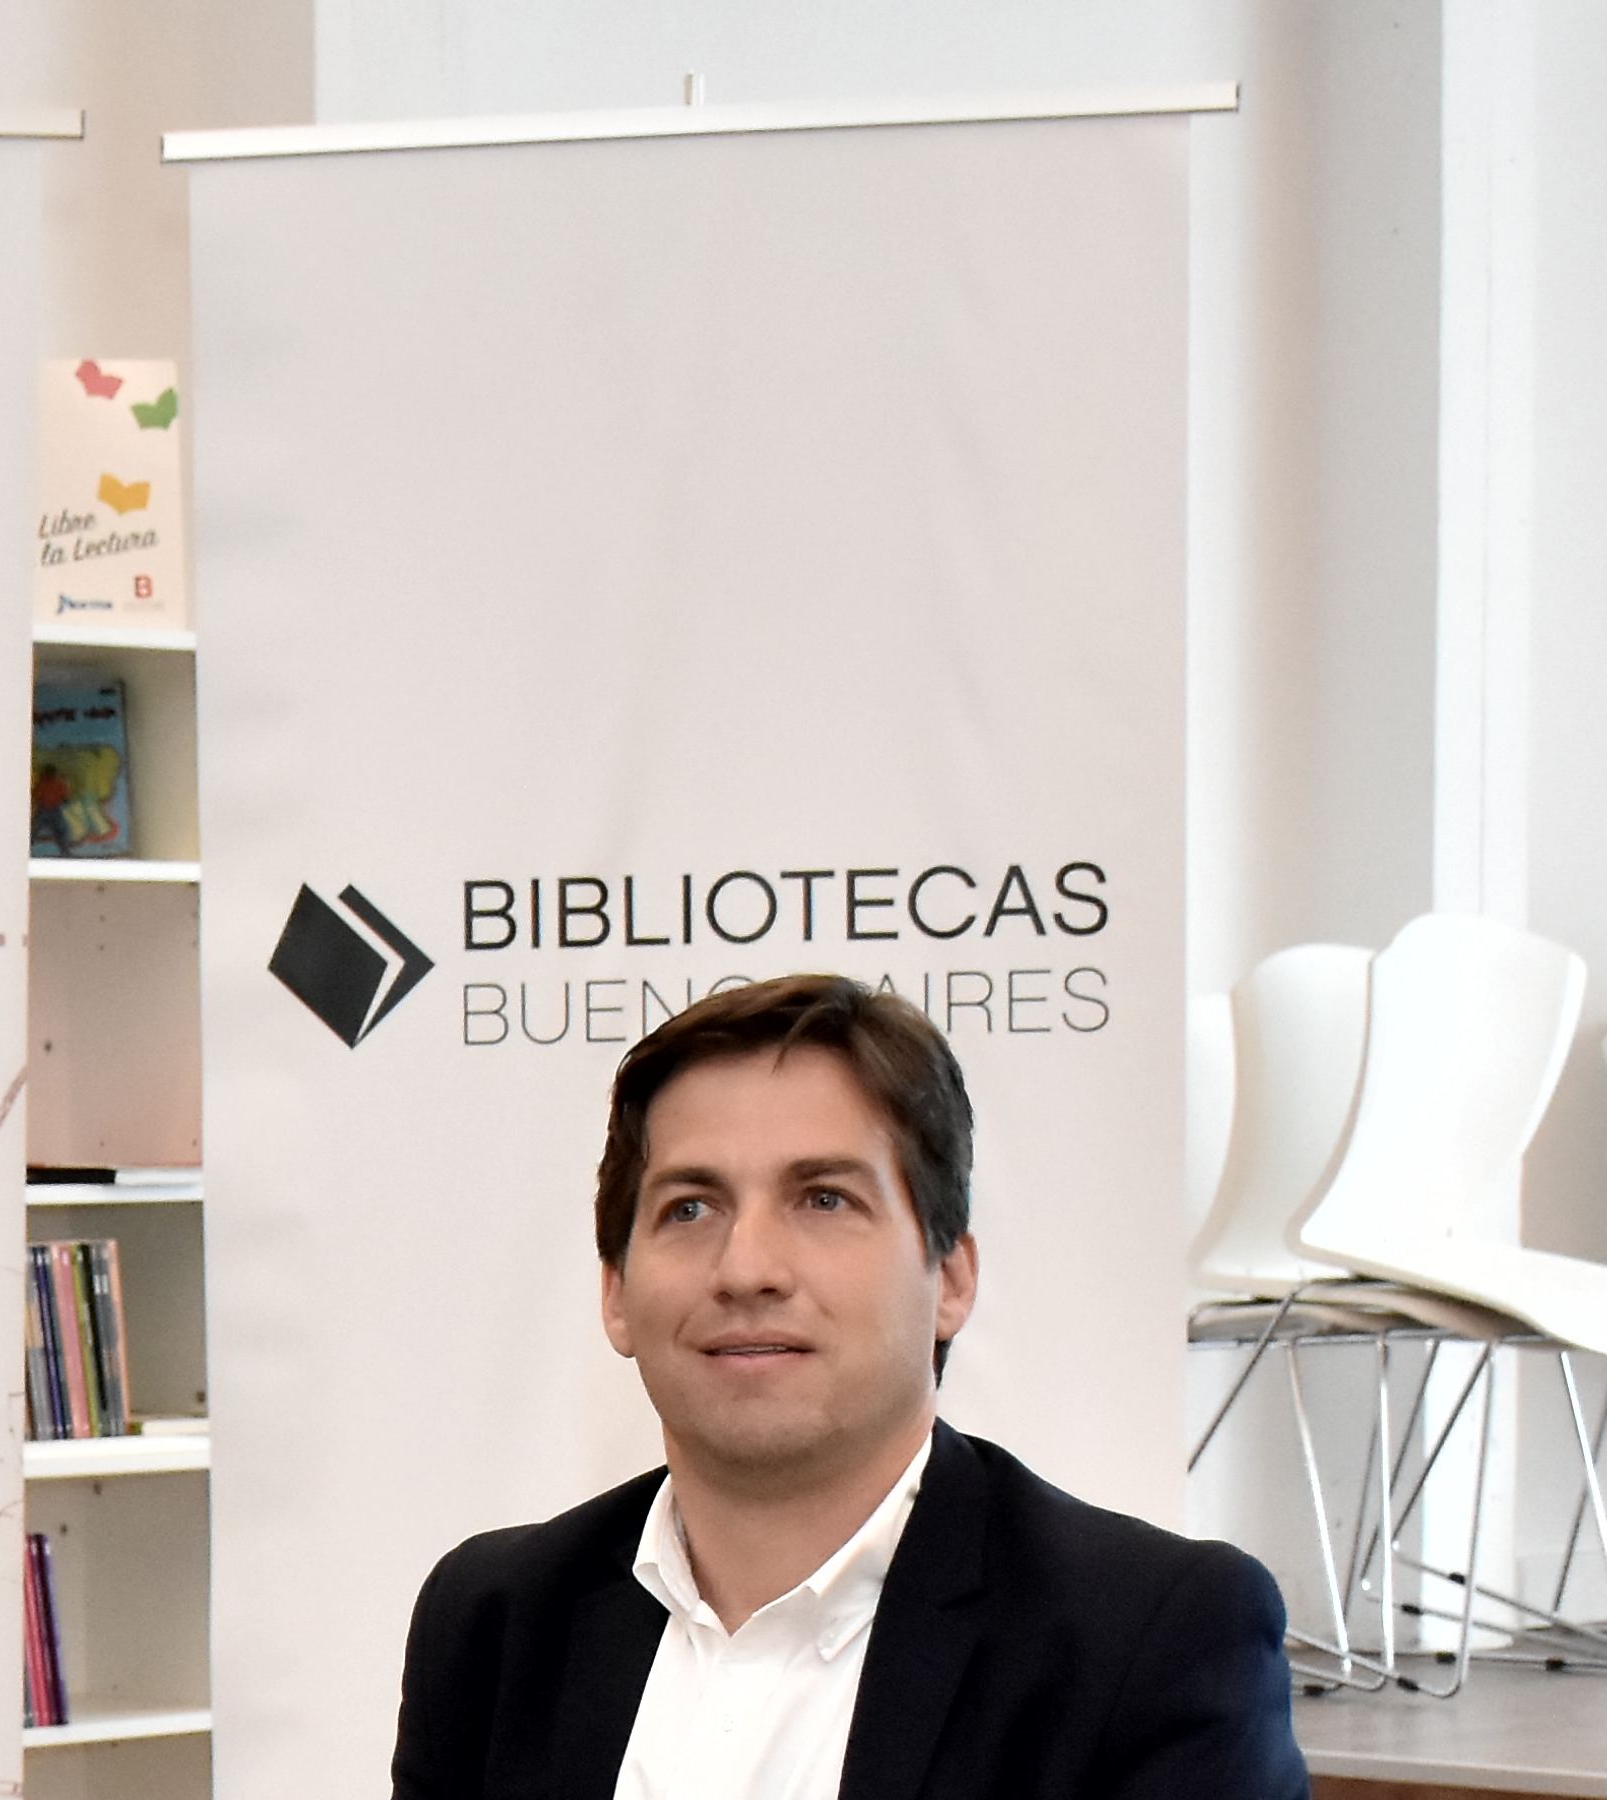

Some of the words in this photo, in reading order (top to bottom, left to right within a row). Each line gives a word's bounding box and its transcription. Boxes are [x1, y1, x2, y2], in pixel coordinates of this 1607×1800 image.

[38, 508, 95, 539] Libre
[72, 529, 159, 562] Lectura
[464, 861, 1109, 951] BIBLIOTECAS
[463, 974, 753, 1047] BUEN
